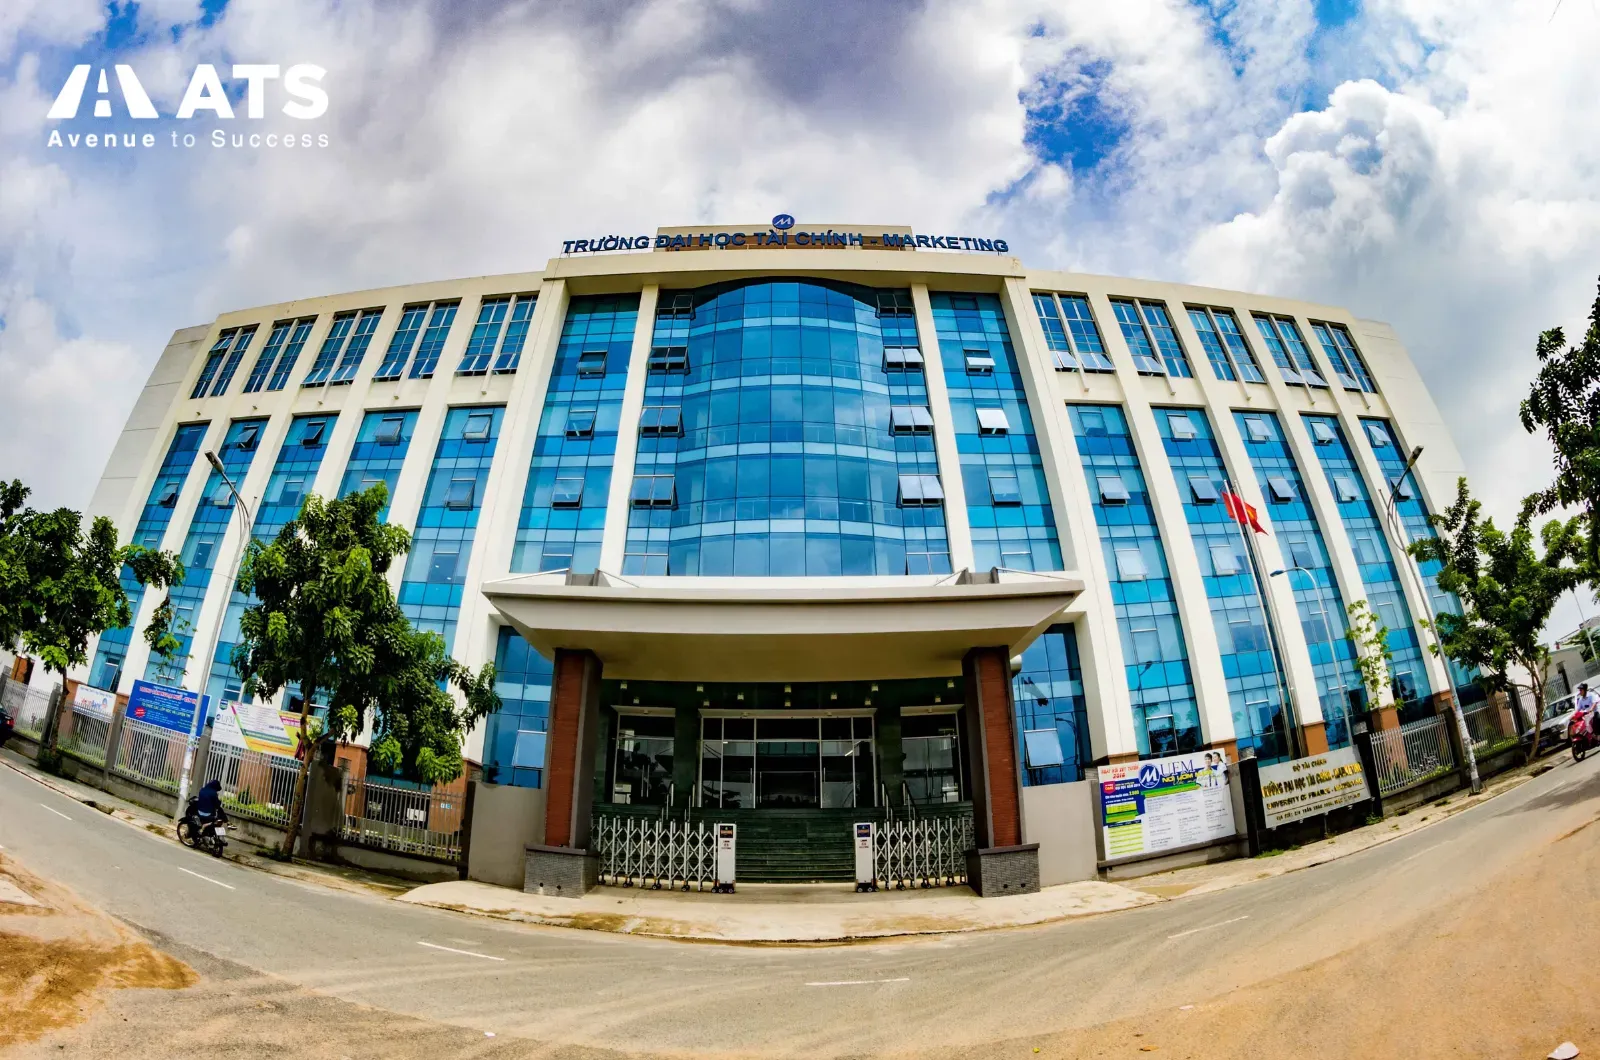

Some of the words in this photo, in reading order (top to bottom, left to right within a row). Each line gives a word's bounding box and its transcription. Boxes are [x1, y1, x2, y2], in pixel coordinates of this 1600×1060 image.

[563, 235, 650, 254] TRƯỜNG
[654, 234, 692, 252] ĐẠI
[700, 232, 746, 250] HỌC
[753, 229, 788, 246] TÀI
[795, 229, 863, 246] CHÍNH
[882, 233, 1009, 252] MARKETING
[1160, 760, 1196, 777] UFM
[1266, 796, 1300, 810] UNIVERSITY
